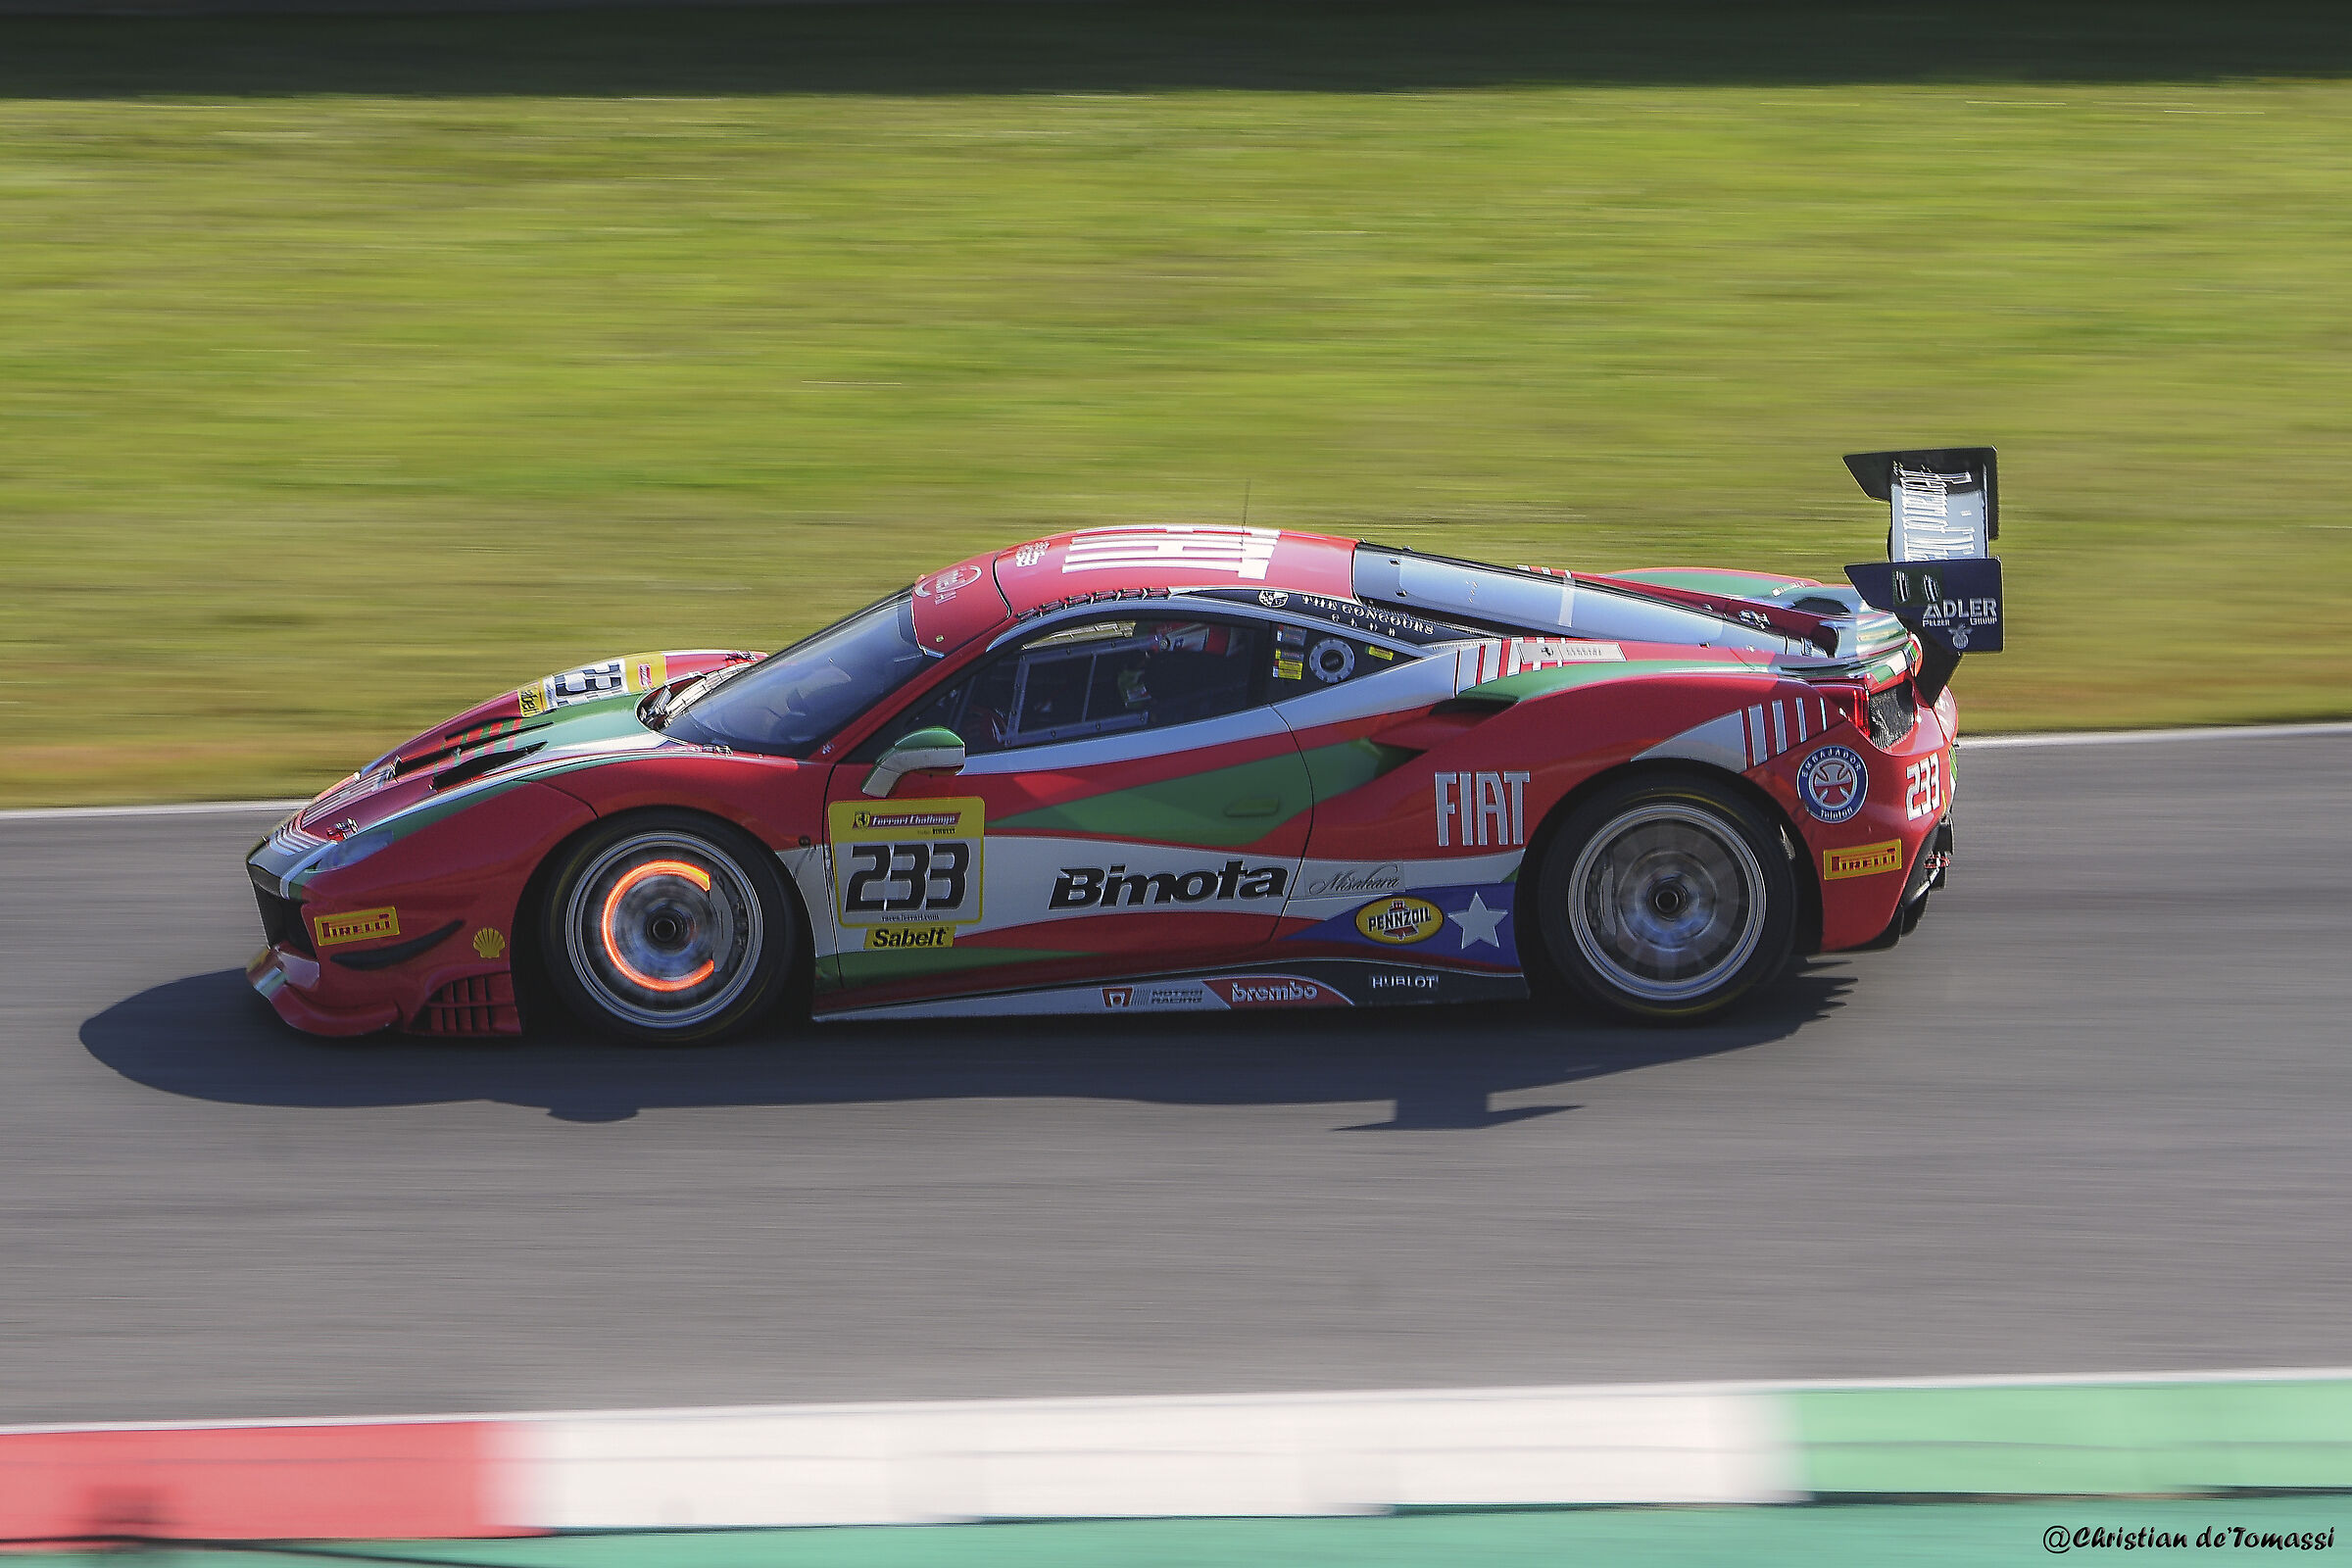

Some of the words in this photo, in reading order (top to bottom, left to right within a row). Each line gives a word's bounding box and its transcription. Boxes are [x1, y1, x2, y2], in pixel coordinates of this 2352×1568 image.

[1301, 595, 1338, 611] THE
[1342, 603, 1434, 635] CONCOURS
[1923, 598, 1997, 618] ADLER
[1801, 748, 1862, 778] EMBAJADOR
[1906, 752, 1941, 821] 233
[1435, 771, 1531, 847] FIAT
[845, 843, 970, 912] 233
[1048, 859, 1289, 910] Bimota
[1367, 906, 1432, 932] PENNZOIL
[872, 927, 947, 948] Sabelt
[1231, 980, 1318, 1003] brembo
[1371, 974, 1436, 989] HUBLOT
